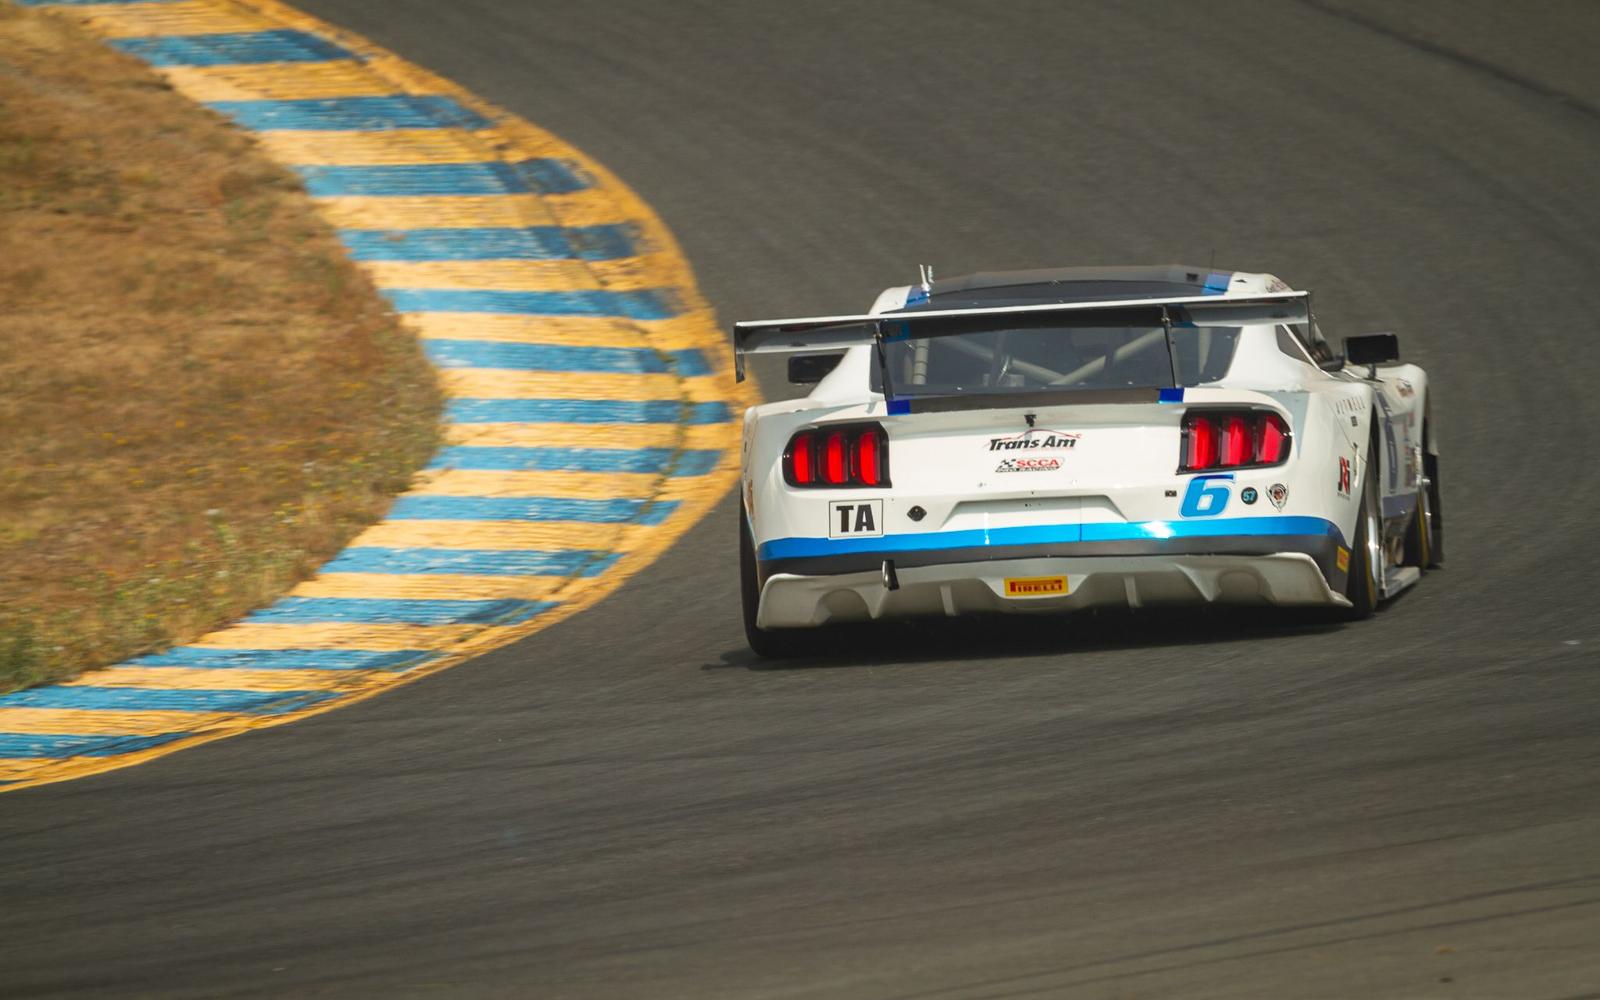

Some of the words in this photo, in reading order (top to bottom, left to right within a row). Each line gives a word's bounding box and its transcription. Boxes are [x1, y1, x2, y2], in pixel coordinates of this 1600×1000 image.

[989, 438, 1040, 451] Trans
[1041, 435, 1077, 448] Am
[1016, 458, 1059, 468] SCCA
[1180, 473, 1234, 518] 6
[836, 503, 875, 533] TA
[1009, 579, 1063, 593] PIRELLI
